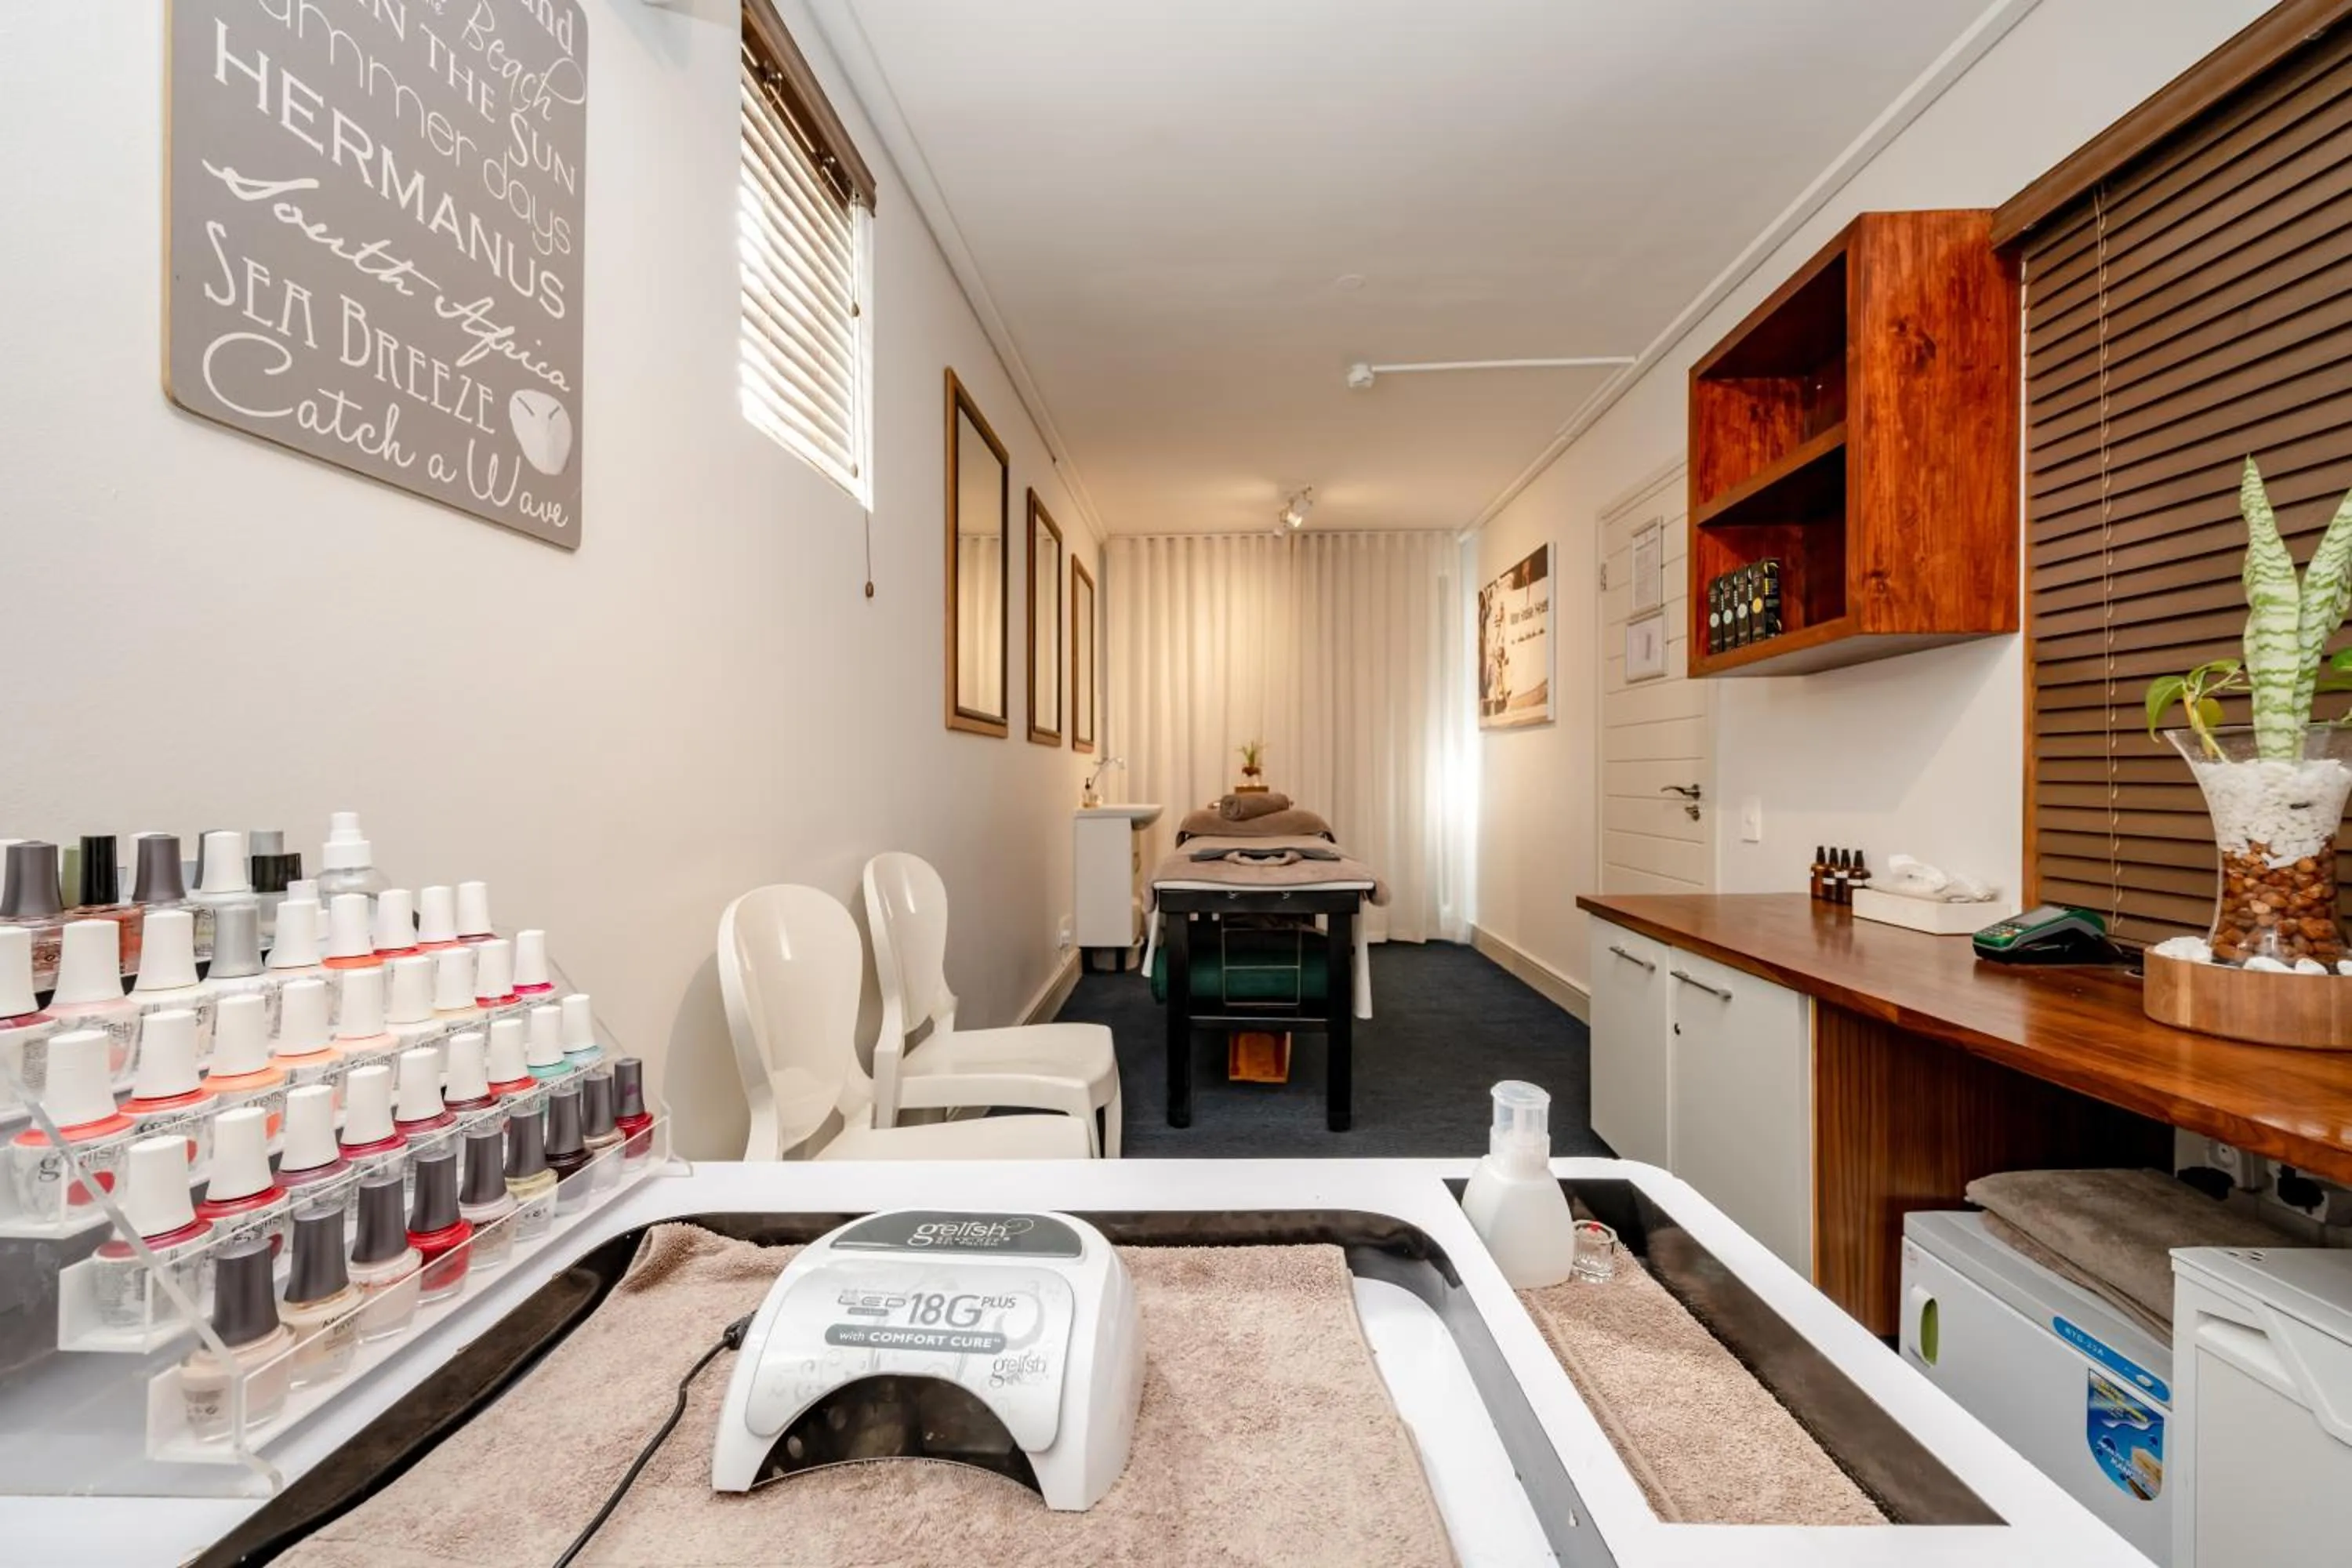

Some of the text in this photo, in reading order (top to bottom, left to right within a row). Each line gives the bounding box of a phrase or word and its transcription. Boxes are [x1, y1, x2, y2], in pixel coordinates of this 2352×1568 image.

[358, 0, 576, 195] N THE SUN
[461, 0, 586, 120] Beach
[521, 0, 573, 56] nd
[213, 16, 566, 319] HERMANUS
[482, 149, 572, 256] days
[201, 158, 572, 393] South Africa
[203, 220, 497, 434] SEA BREEZE
[202, 332, 570, 528] Catch a Wave
[839, 1331, 865, 1345] with
[869, 1331, 947, 1347] COMFORT
[909, 1292, 982, 1328] 18G
[981, 1295, 1017, 1310] PLUS
